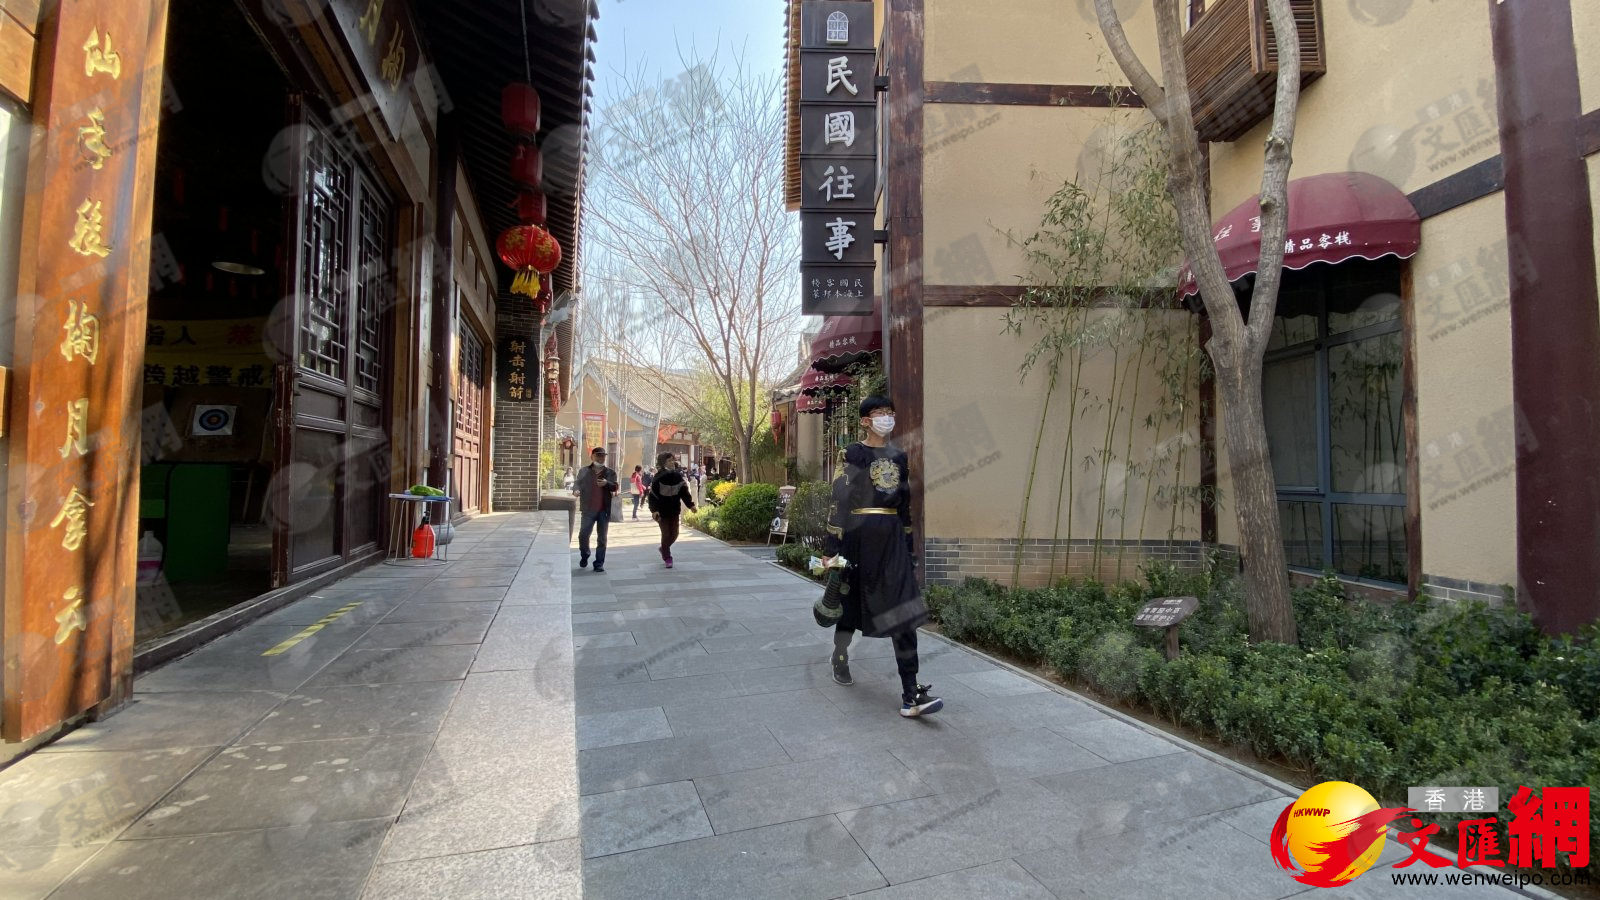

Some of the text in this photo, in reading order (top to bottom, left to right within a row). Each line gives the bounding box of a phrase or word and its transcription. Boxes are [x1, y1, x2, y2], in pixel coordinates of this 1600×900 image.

[819, 56, 859, 261] 民國往事
[1284, 231, 1352, 254] 精品客栈
[143, 363, 273, 387] 跨越警戒
